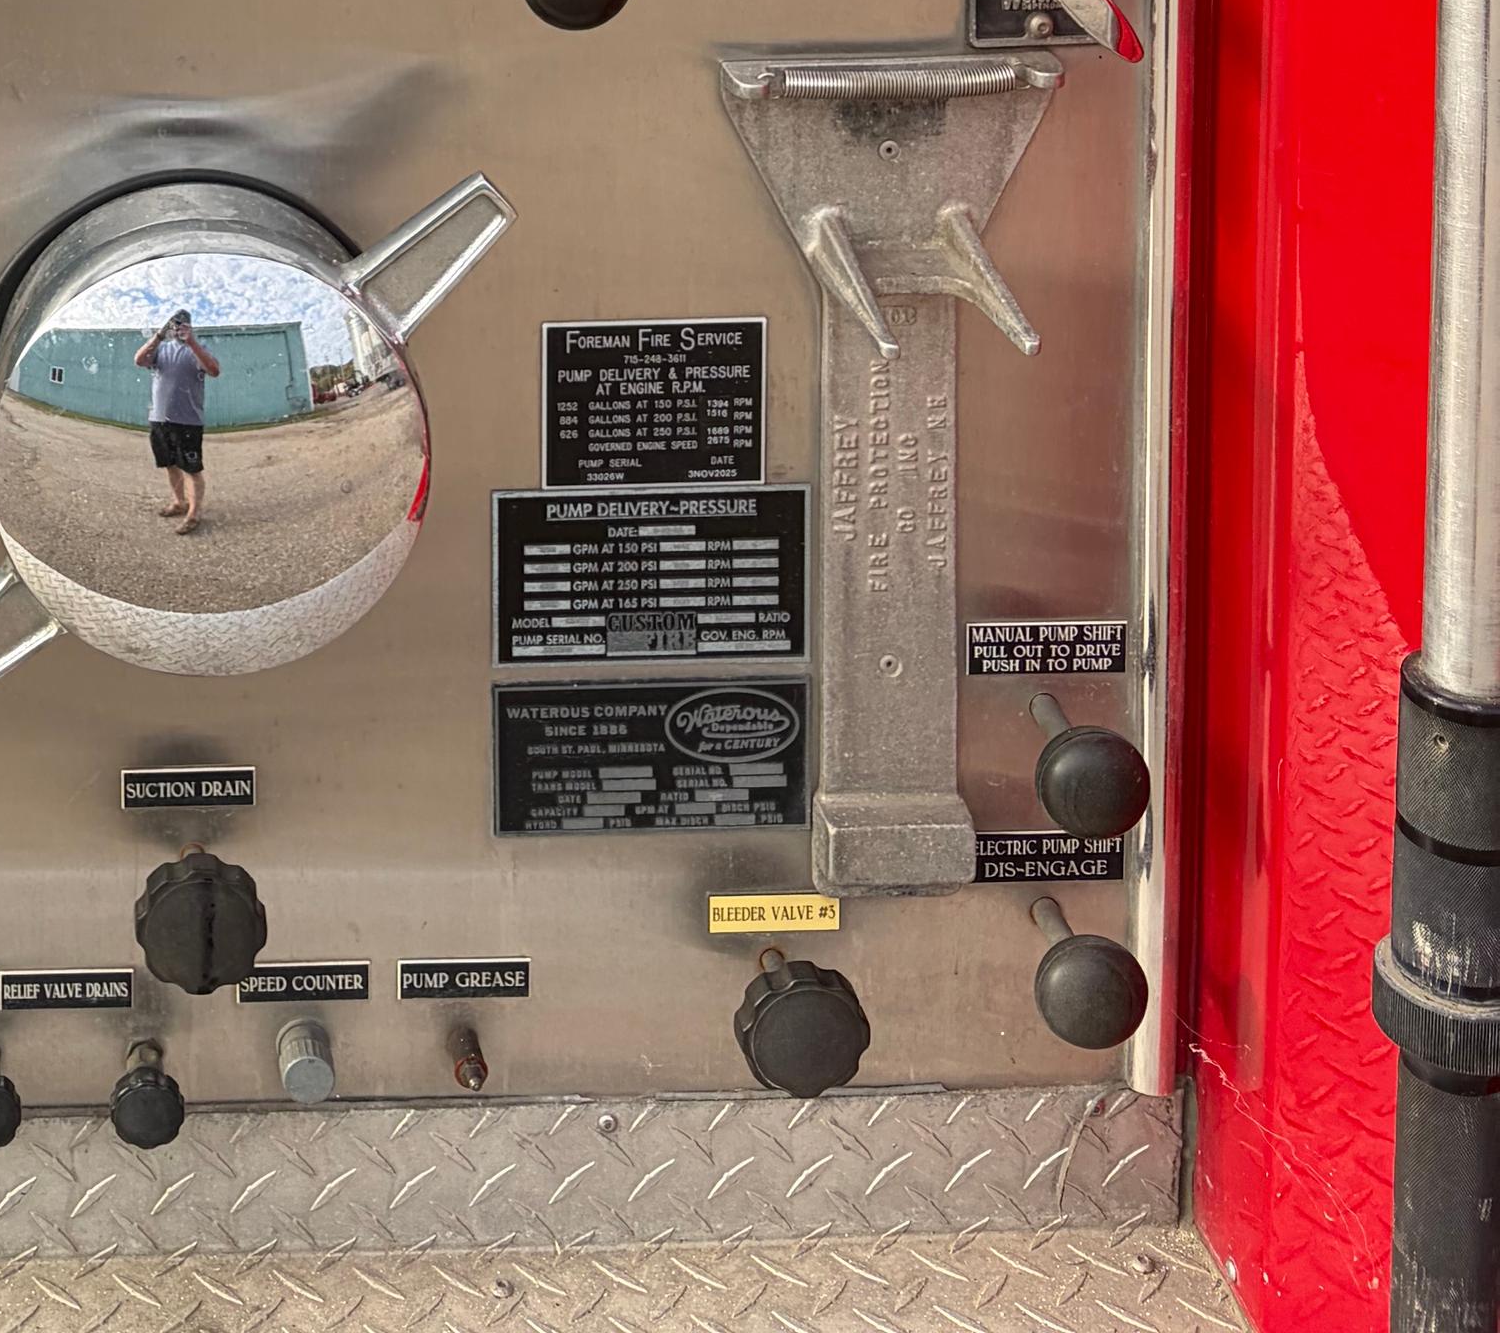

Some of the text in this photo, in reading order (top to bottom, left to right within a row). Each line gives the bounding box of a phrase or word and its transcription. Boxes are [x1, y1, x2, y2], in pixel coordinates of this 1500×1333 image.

[558, 366, 750, 382] PUMP DELIVERY & PRESSURE
[596, 384, 611, 395] AT
[620, 382, 664, 394] ENGINE
[972, 625, 1123, 644] MANUAL PUMP SHIFT
[974, 643, 1121, 659] PULL OUT TO DRIVE
[983, 657, 1112, 673] PUSH IN TO PUMP
[126, 778, 251, 799] SUCTION DRAIN
[985, 860, 1108, 878] DIS-ENGAGE
[712, 906, 766, 922] BLEEDER
[771, 905, 813, 920] VALVE
[240, 974, 364, 994] SPEED COUNTER
[403, 969, 525, 990] PUMP GREASE
[4, 980, 129, 1000] RELIEF VALVE DRAINS
